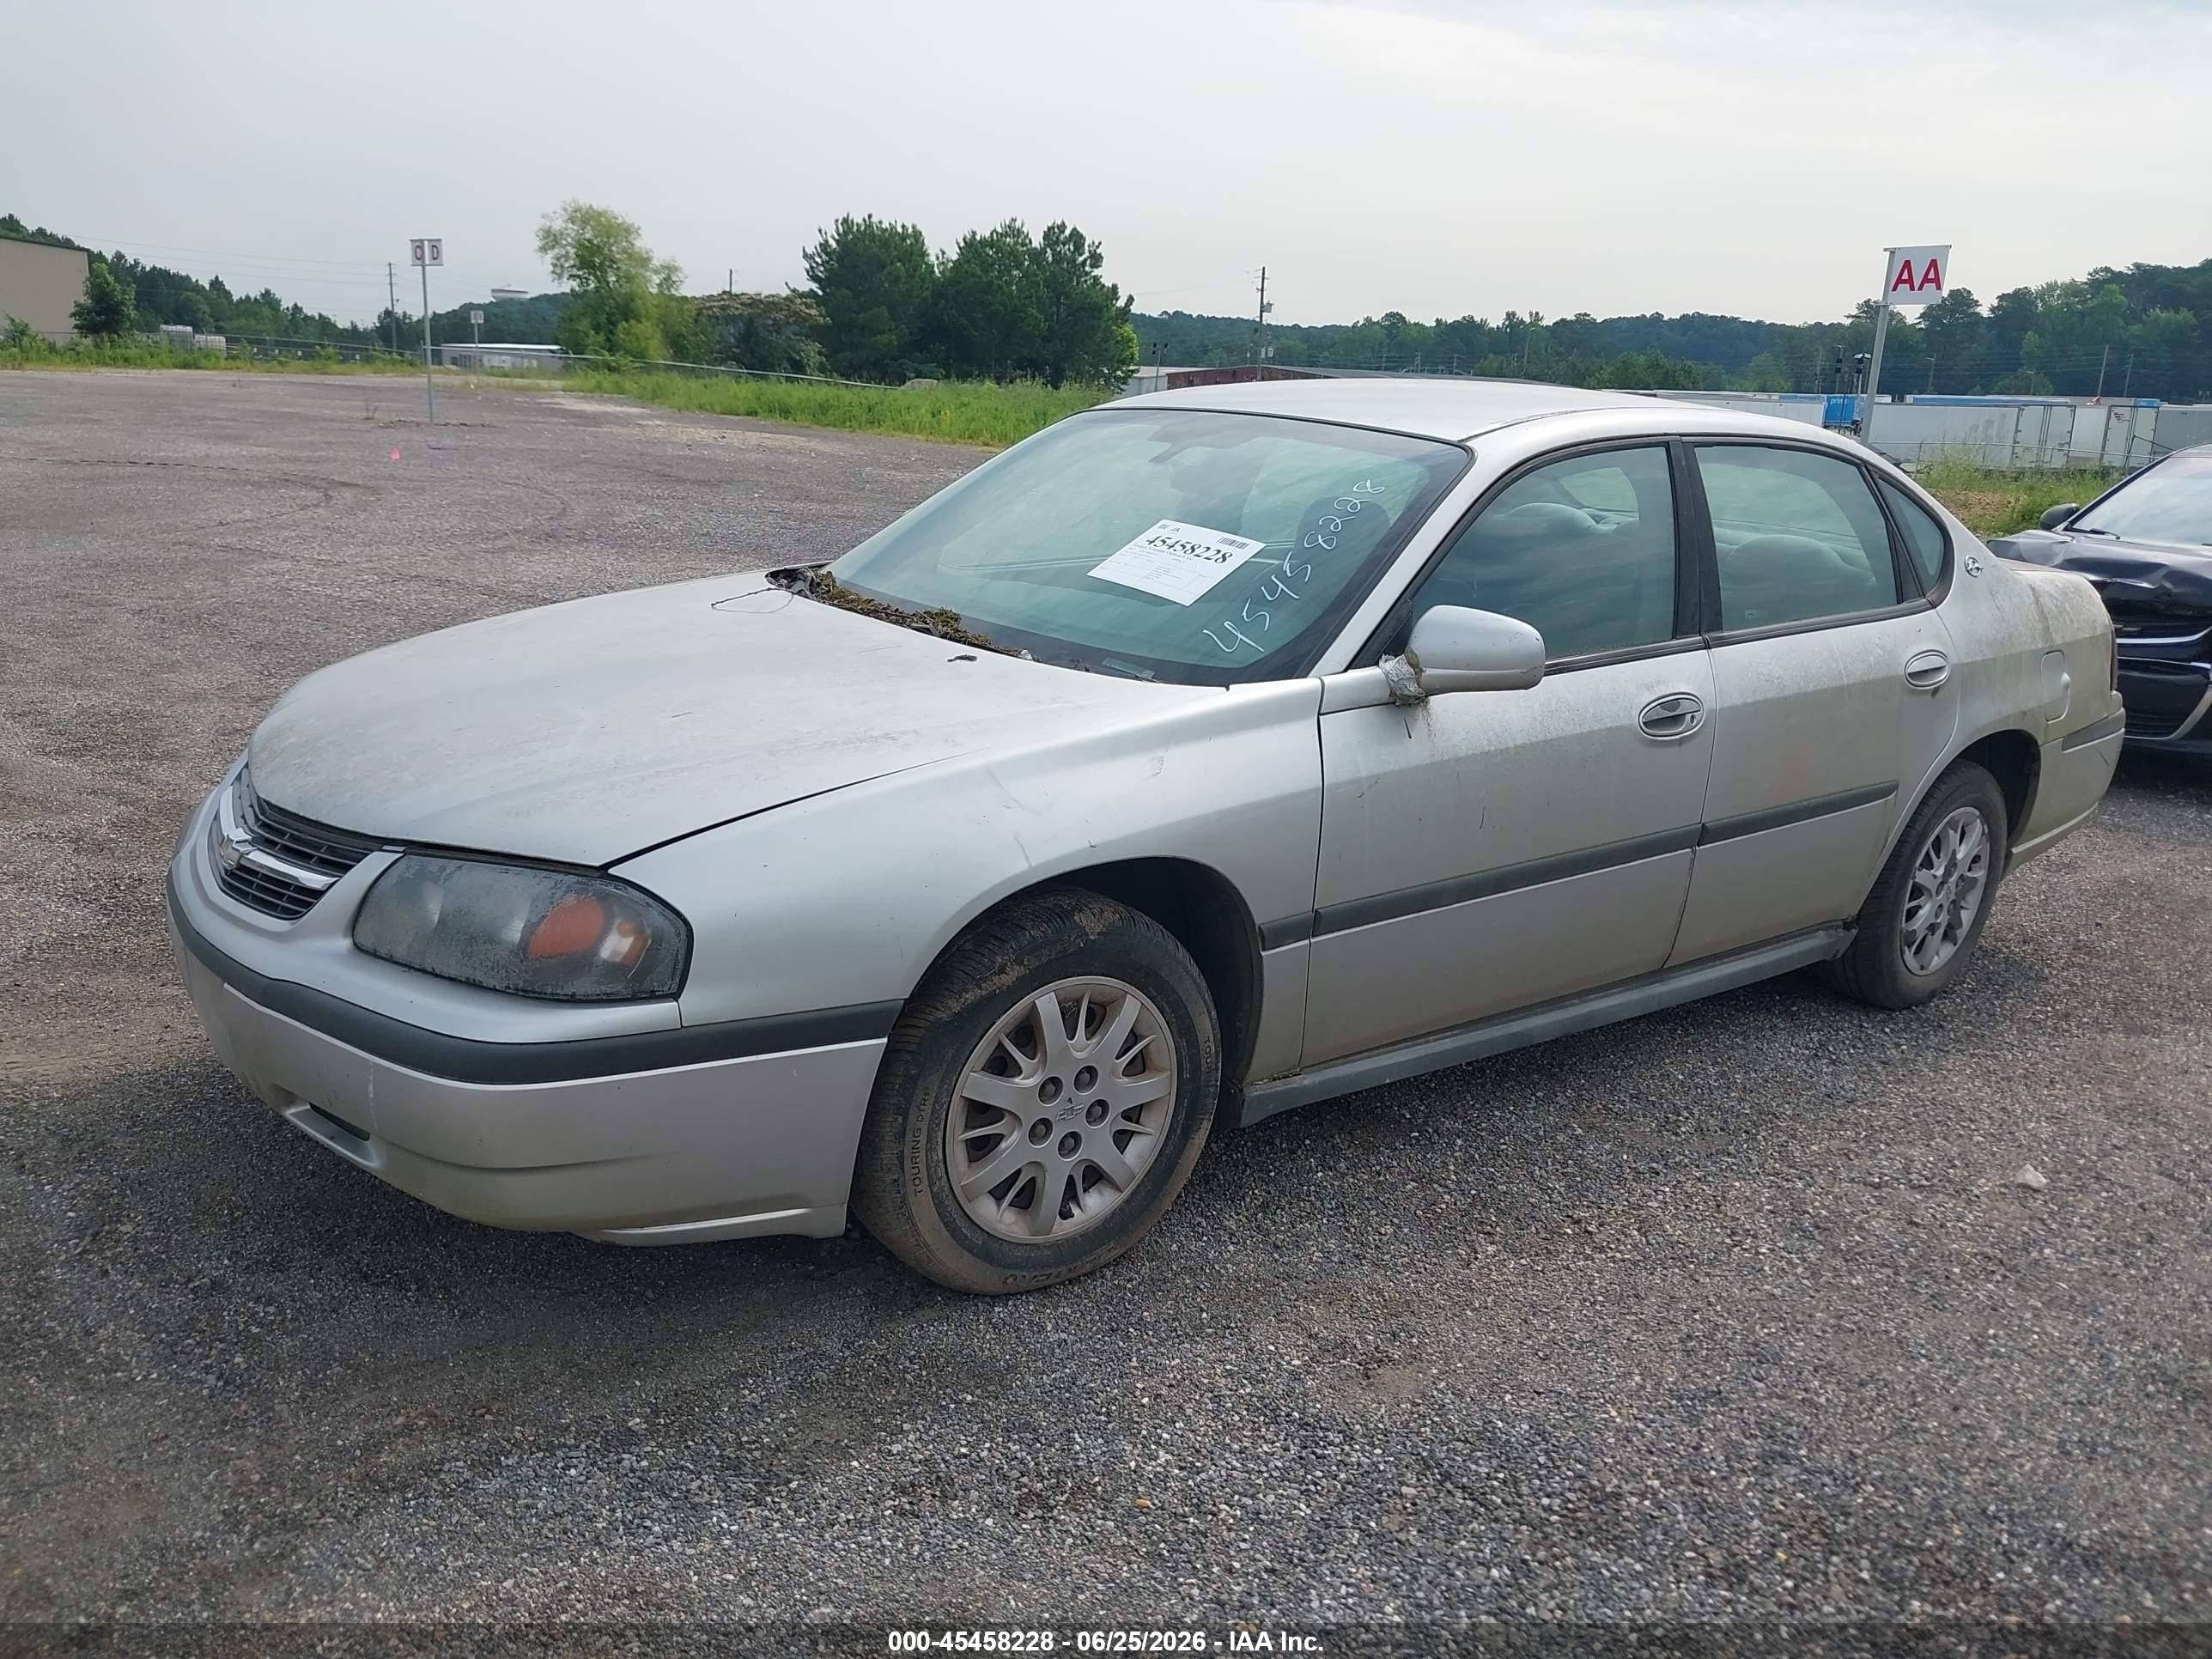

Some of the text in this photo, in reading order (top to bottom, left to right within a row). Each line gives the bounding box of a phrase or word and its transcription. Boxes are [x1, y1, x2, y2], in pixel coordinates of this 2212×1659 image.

[431, 244, 440, 261] D
[1891, 258, 1942, 292] AA
[1146, 535, 1234, 564] 45458228
[1203, 479, 1385, 653] 45458228
[910, 1127, 924, 1198] TOURING
